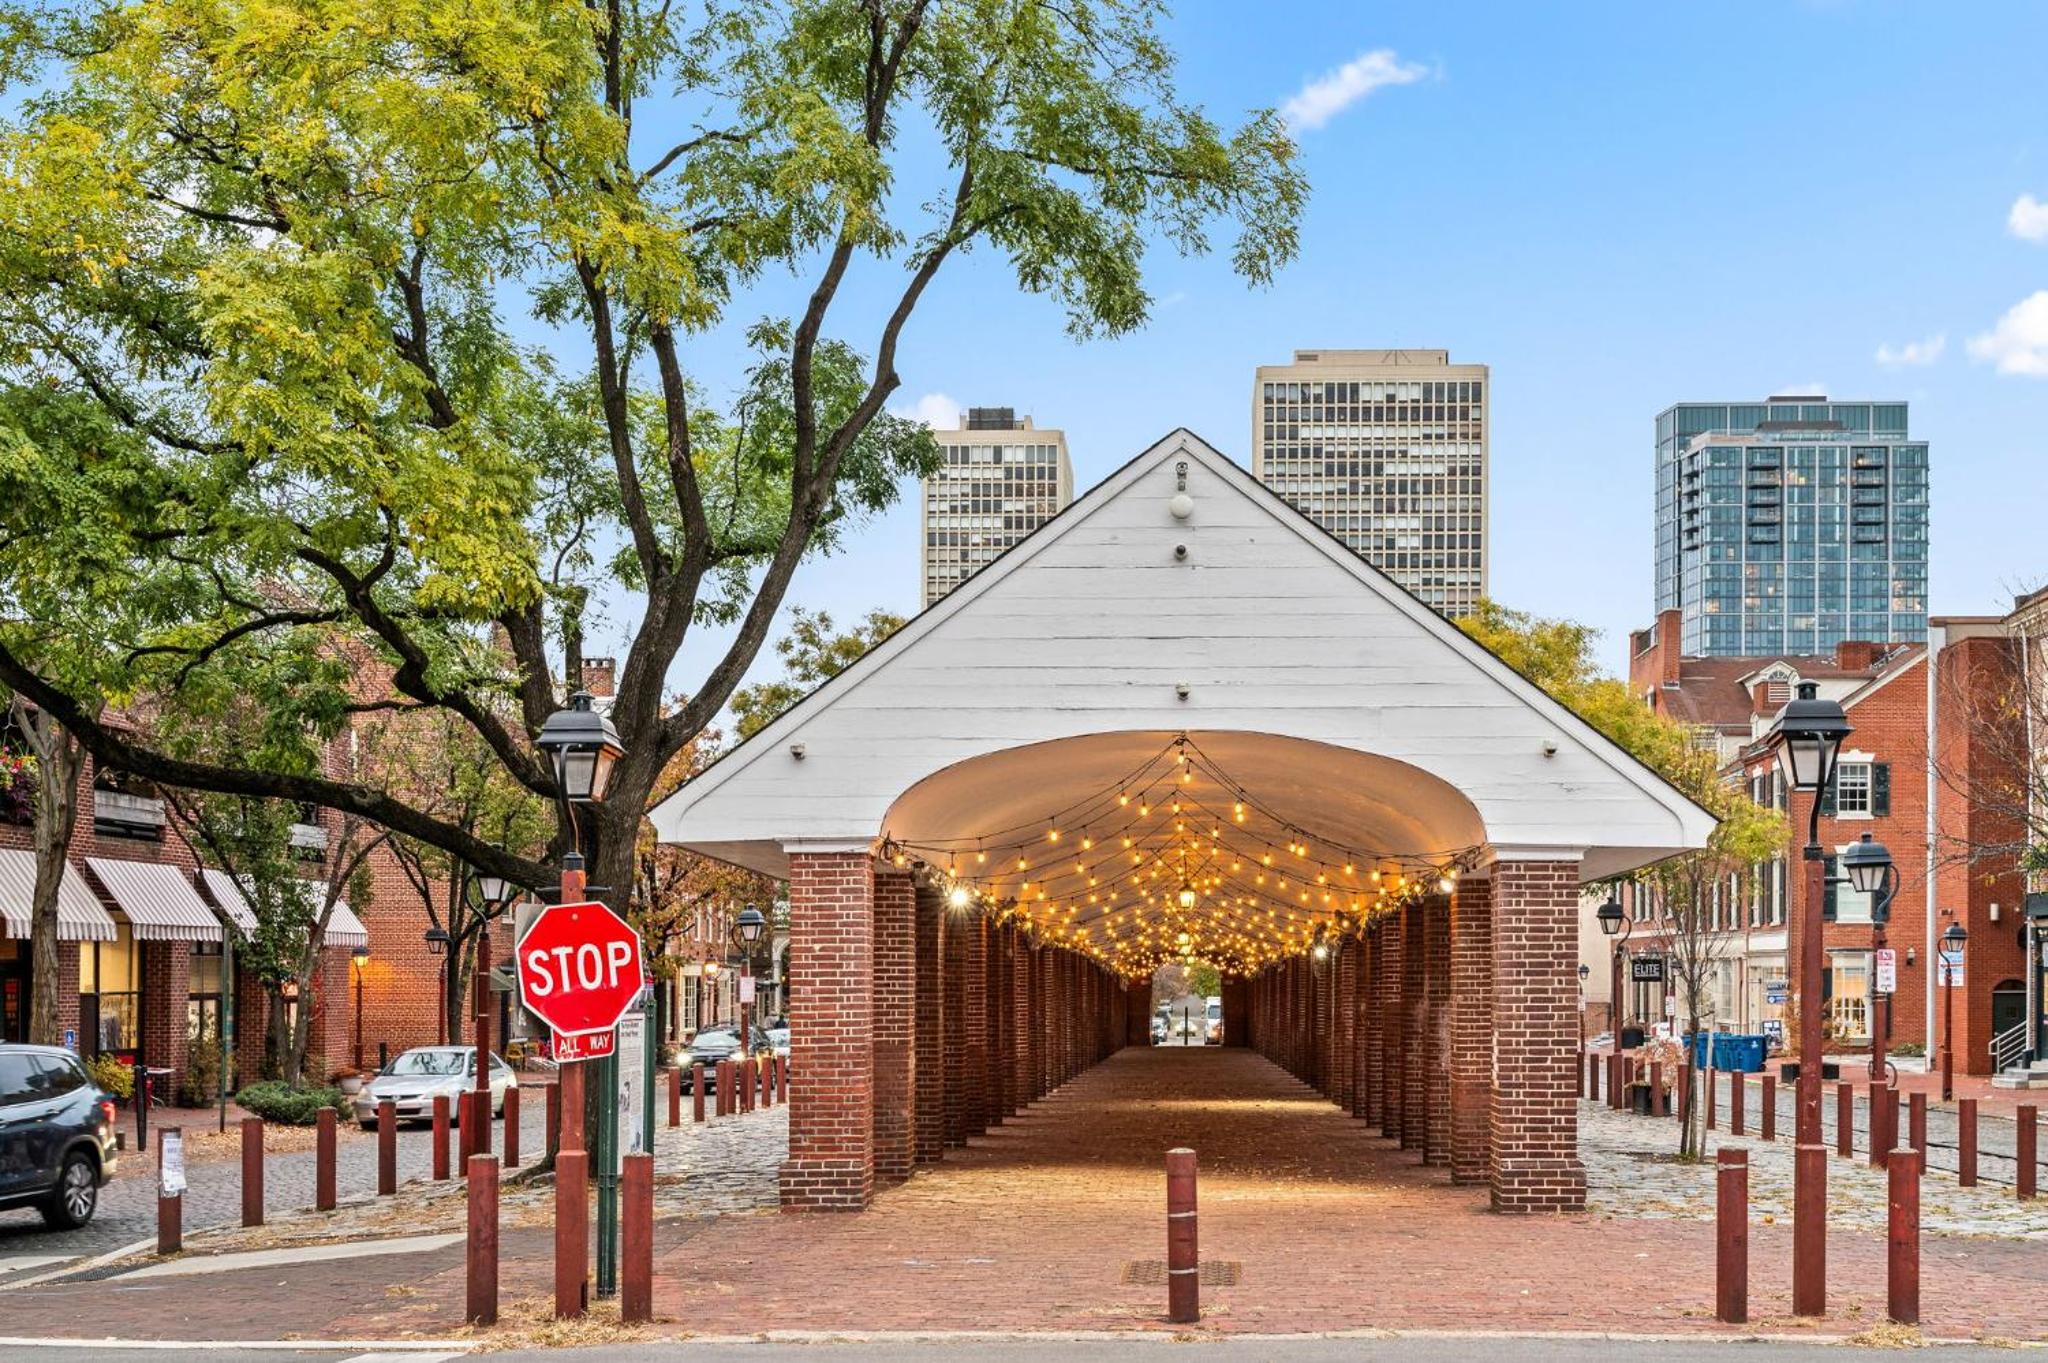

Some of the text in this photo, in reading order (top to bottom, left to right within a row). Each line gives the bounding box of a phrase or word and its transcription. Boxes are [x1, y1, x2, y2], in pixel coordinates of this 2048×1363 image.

[528, 941, 631, 996] STOP
[1634, 963, 1660, 976] ELITE
[559, 1037, 581, 1054] ALL
[590, 1034, 610, 1050] WAY
